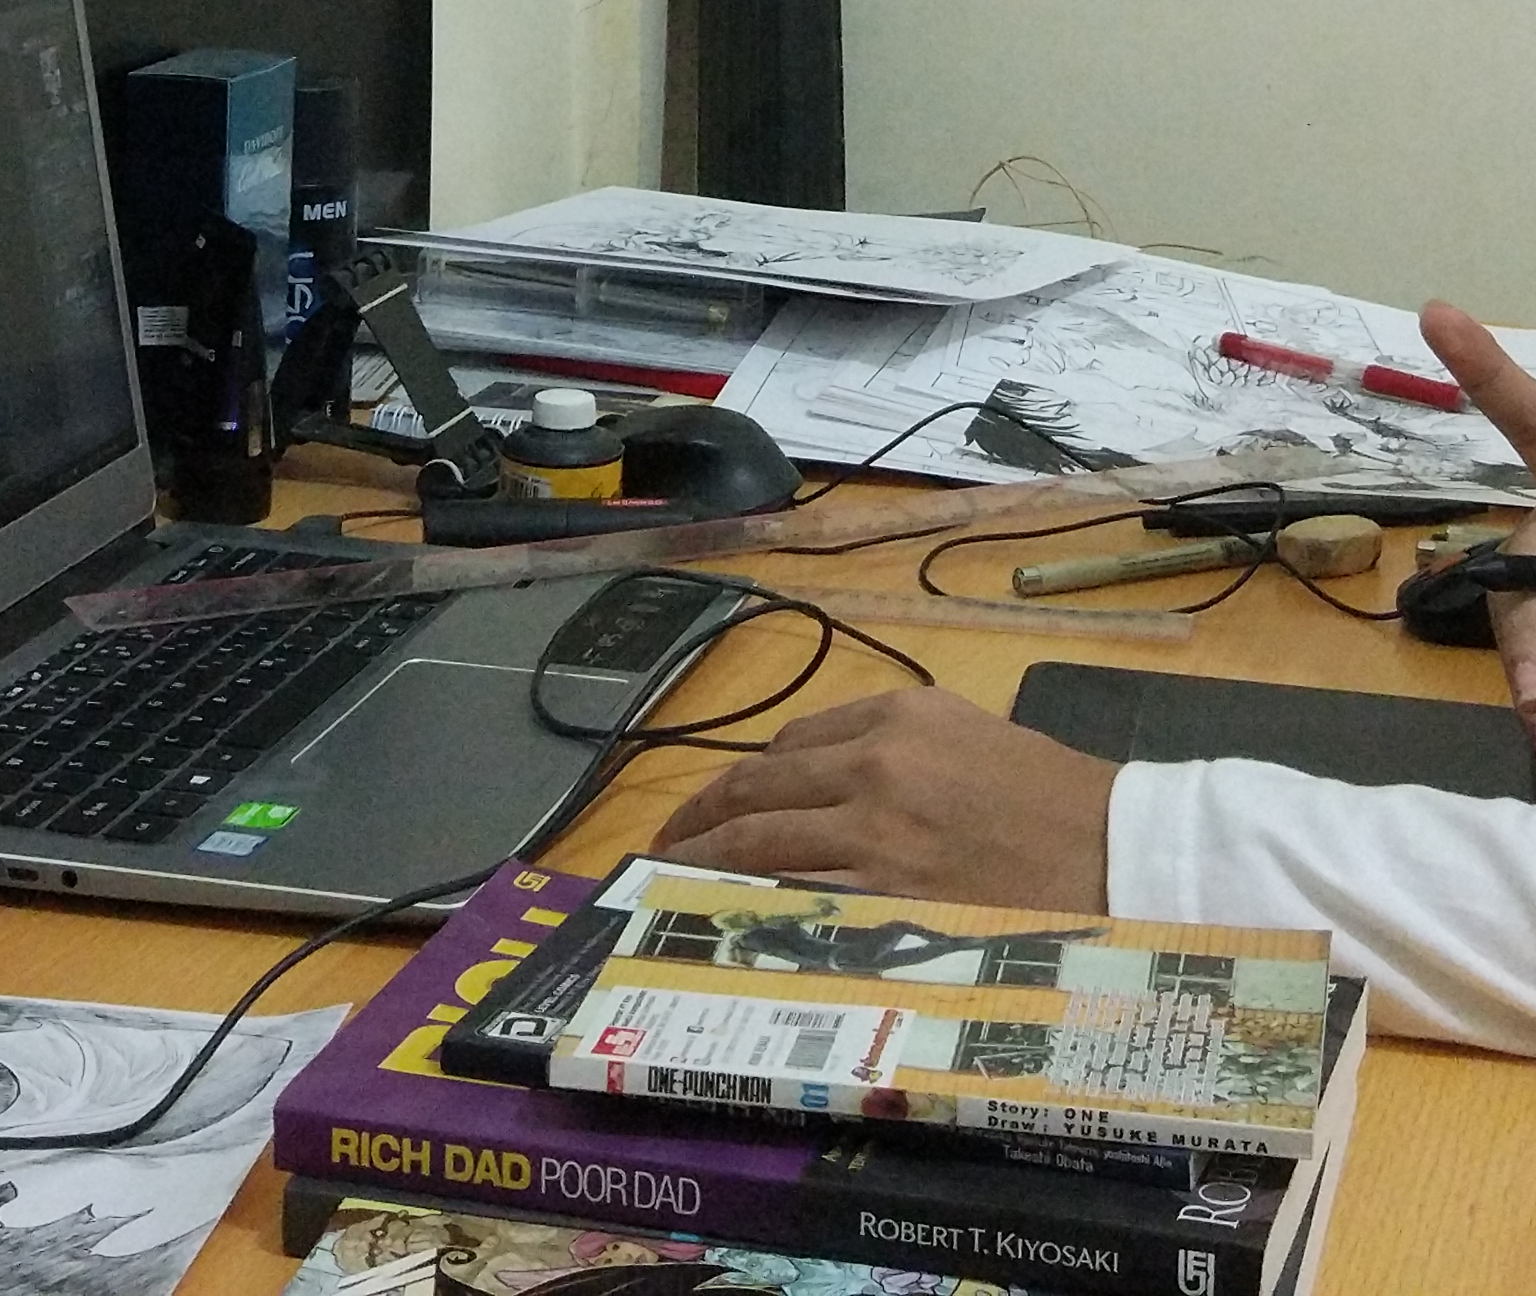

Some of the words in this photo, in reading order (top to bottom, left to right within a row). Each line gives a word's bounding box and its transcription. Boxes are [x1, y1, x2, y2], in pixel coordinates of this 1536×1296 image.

[303, 200, 348, 221] MEN
[1064, 1107, 1110, 1124] ONE
[1064, 1123, 1158, 1144] YUSUKE
[1172, 1133, 1269, 1155] MURATA
[331, 1128, 431, 1177] RICH
[444, 1144, 532, 1191] DAD
[540, 1157, 628, 1207] POOR
[632, 1170, 701, 1216] DAD
[859, 1211, 964, 1251] ROBERT
[967, 1227, 989, 1256] T.
[996, 1231, 1119, 1274] KIYOSAKI
